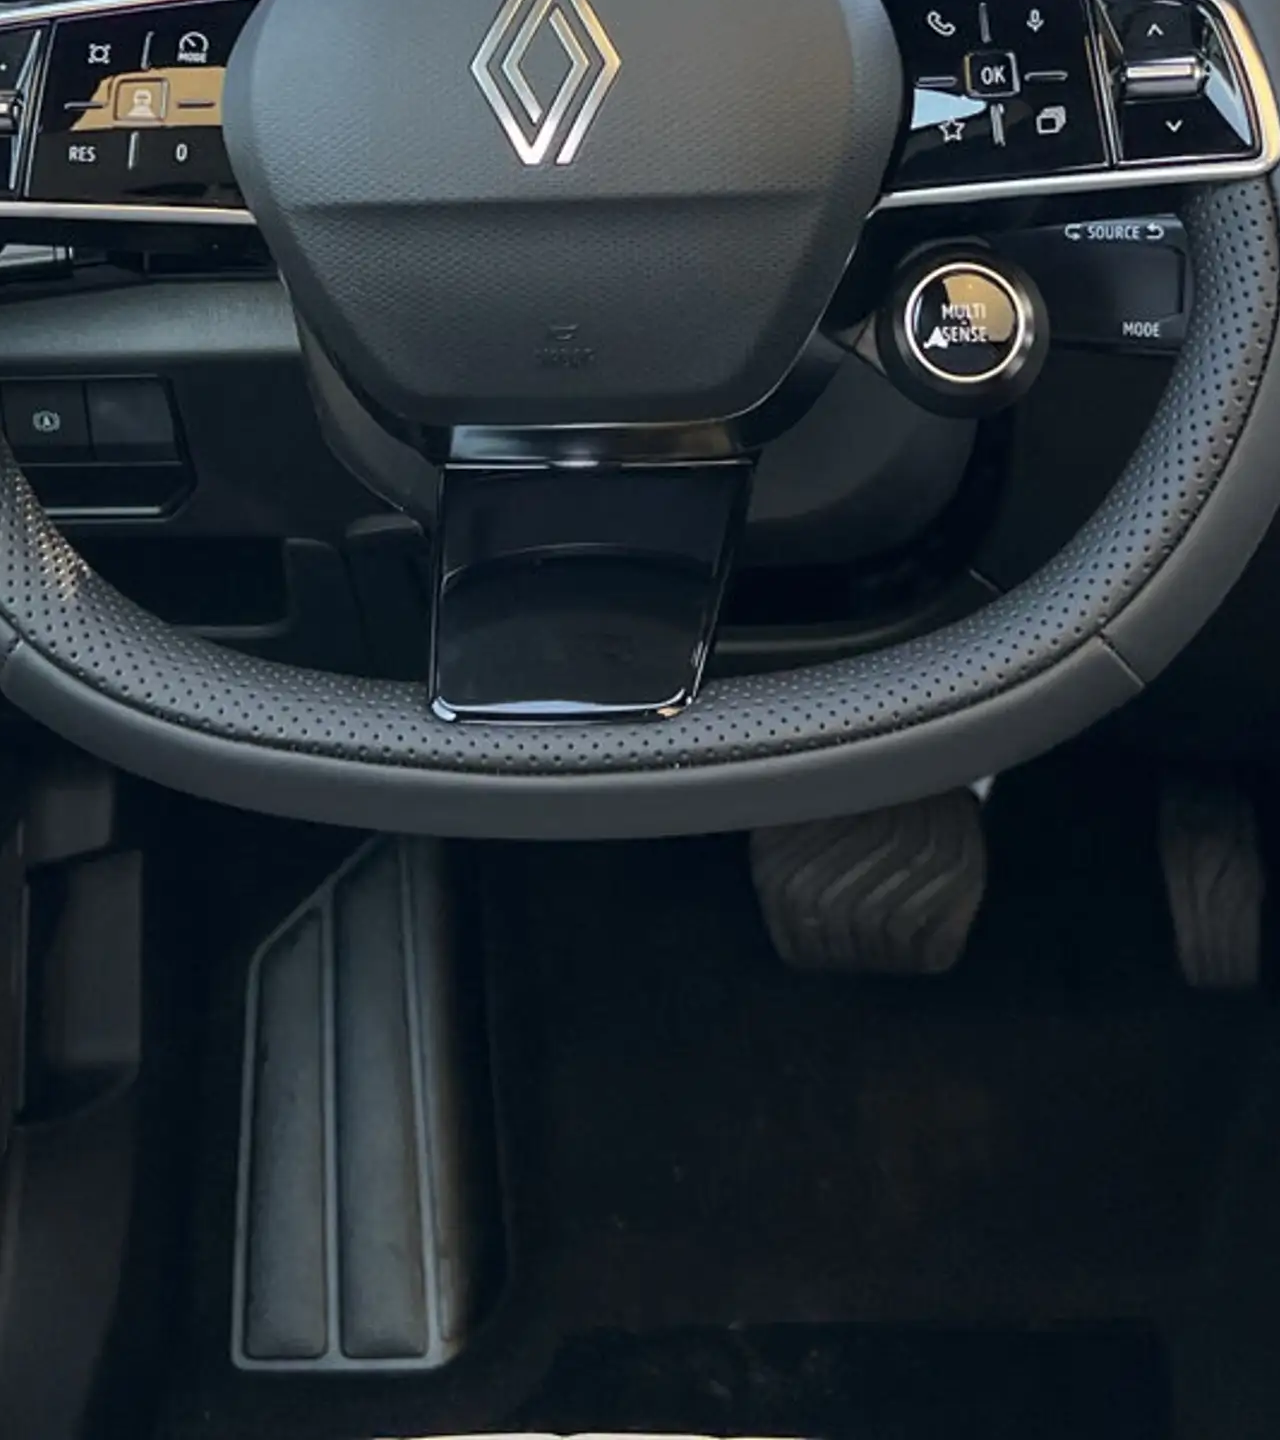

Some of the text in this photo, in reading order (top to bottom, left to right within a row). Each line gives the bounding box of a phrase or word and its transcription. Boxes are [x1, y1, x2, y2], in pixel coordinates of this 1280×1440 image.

[980, 65, 1006, 85] OK
[67, 145, 97, 162] RES
[1086, 224, 1141, 241] SOURCE
[941, 303, 988, 320] MULTI
[941, 326, 989, 344] SENSE
[1122, 321, 1161, 338] MODE
